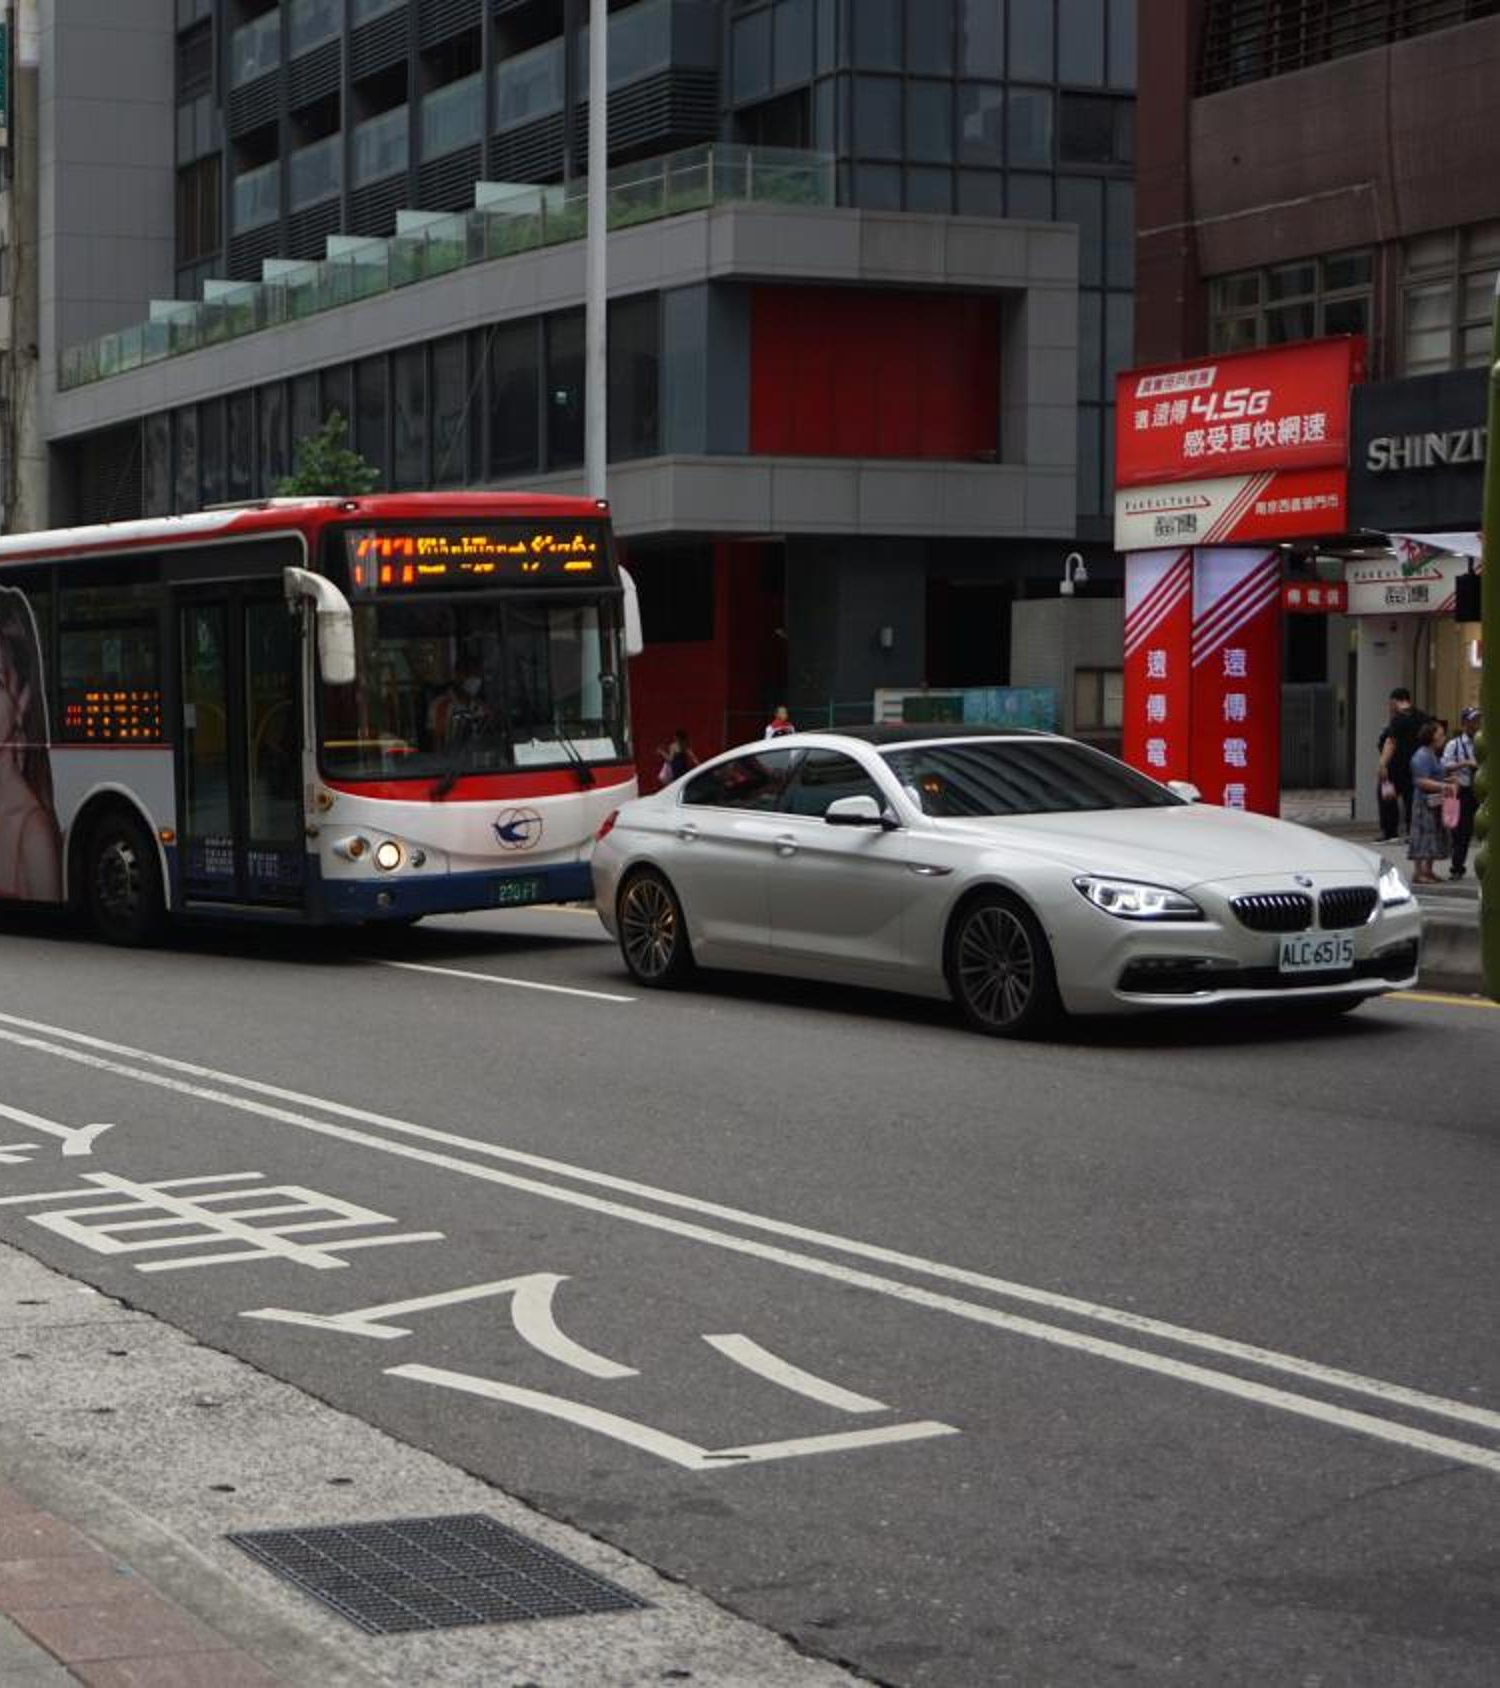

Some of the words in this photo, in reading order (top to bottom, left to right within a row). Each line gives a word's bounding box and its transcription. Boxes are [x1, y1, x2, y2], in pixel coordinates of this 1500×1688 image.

[1191, 388, 1272, 422] 4.5G
[1182, 413, 1326, 458] 感受更快網速
[1366, 427, 1486, 471] SHINZI
